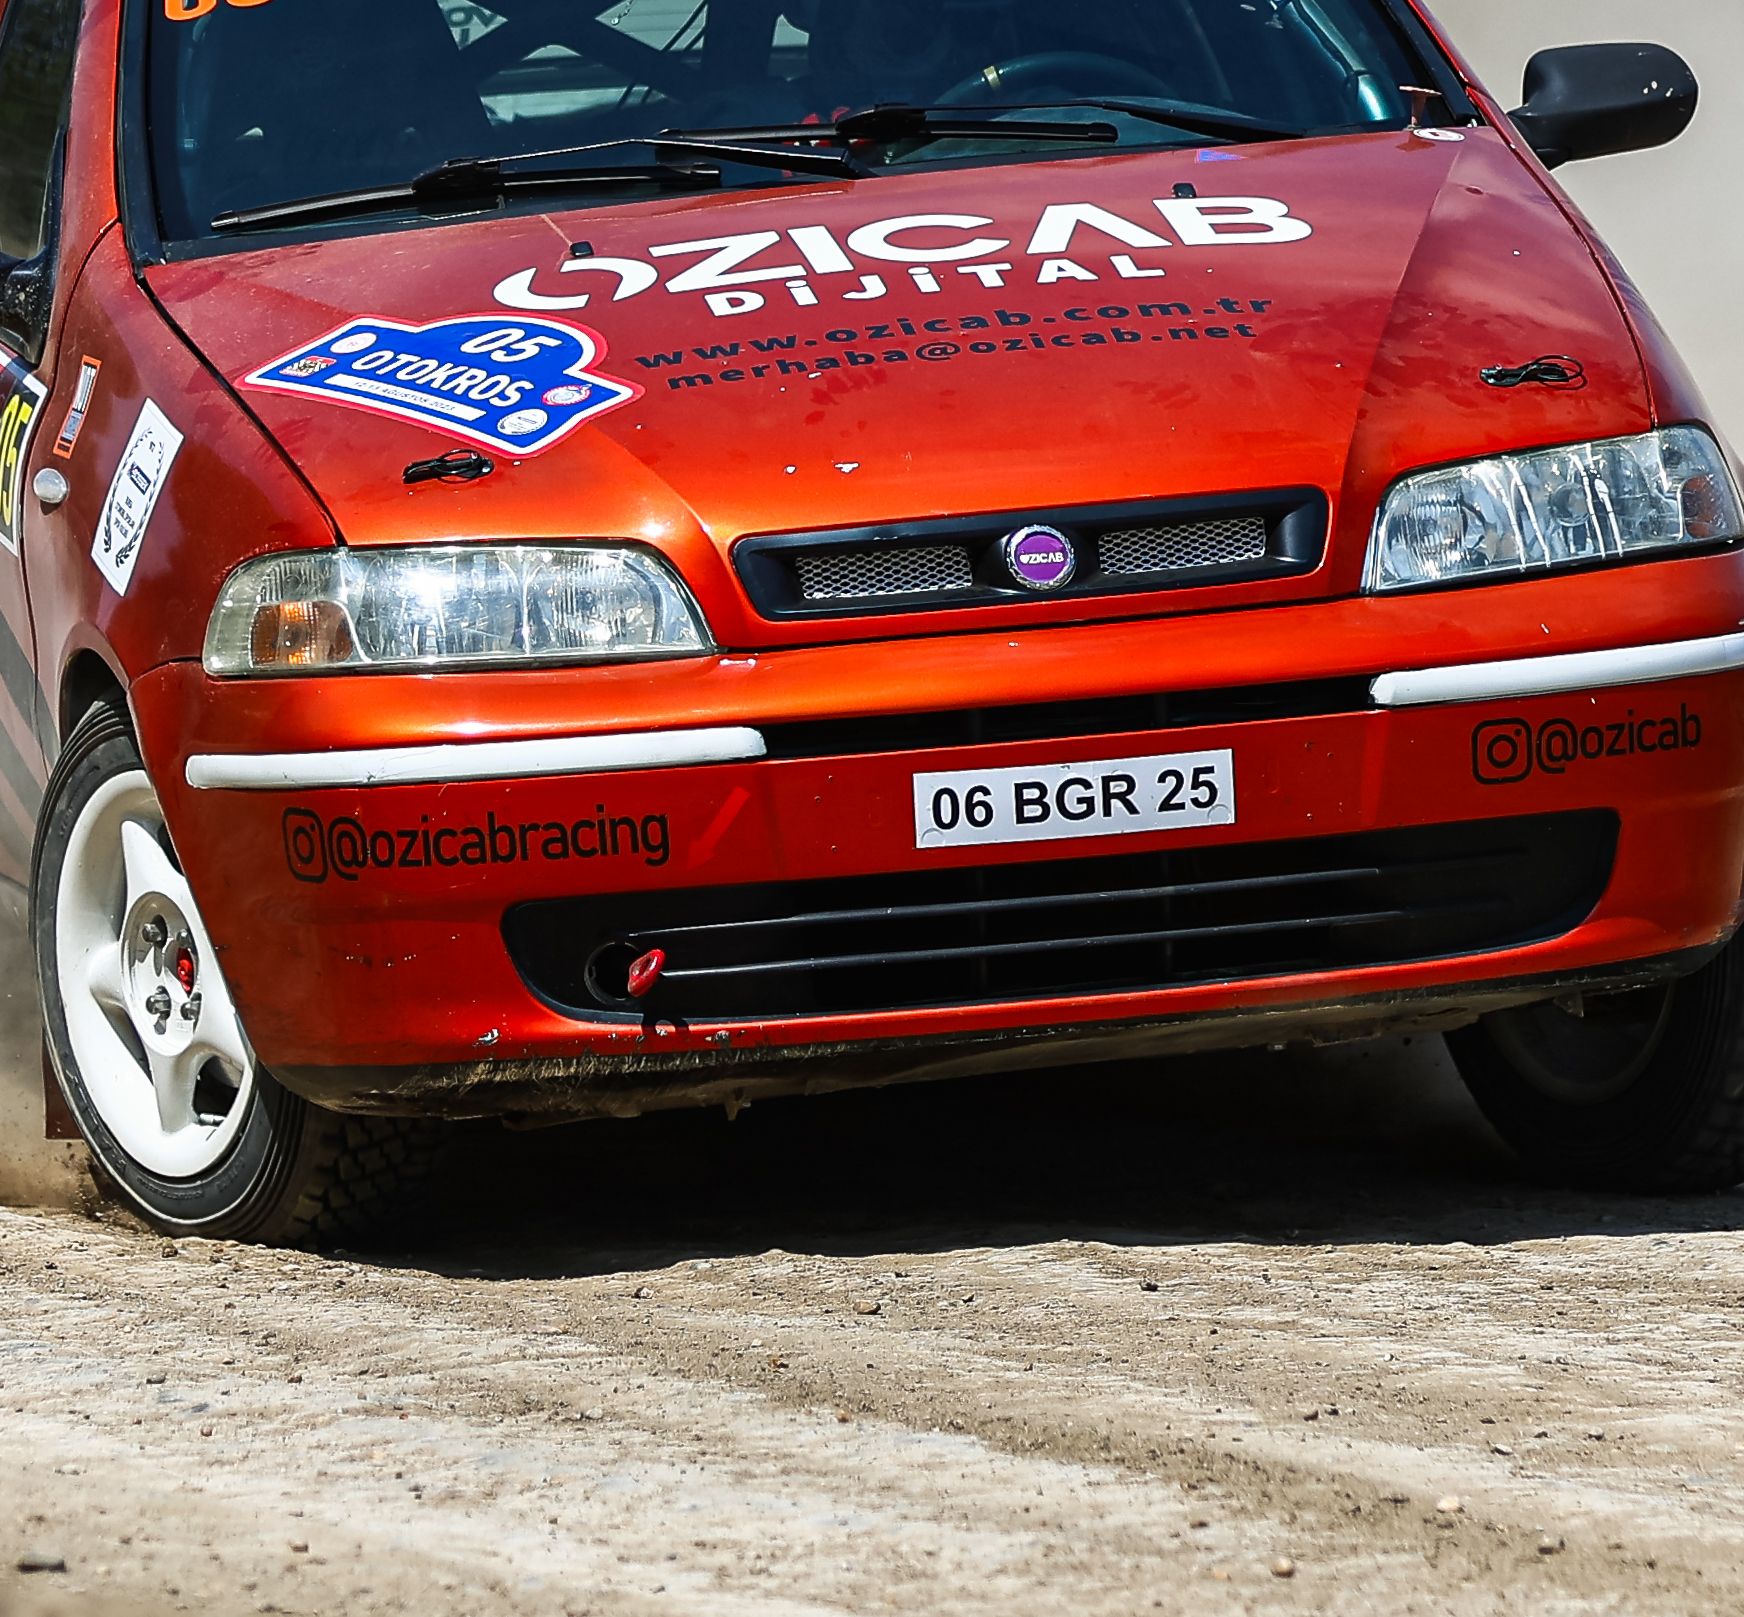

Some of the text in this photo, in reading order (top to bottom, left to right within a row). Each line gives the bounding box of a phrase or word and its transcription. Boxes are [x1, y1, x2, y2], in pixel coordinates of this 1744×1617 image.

[492, 196, 1314, 311] OZICAB
[460, 327, 563, 362] 05
[634, 297, 1273, 369] www.ozicab.com.tr
[667, 322, 1258, 390] merhaba@ozicab.net
[351, 349, 535, 407] OTOKROS
[1536, 702, 1702, 775] @ozicab
[932, 765, 1219, 831] 06 BGR 25
[327, 803, 670, 882] @ozicabracing
